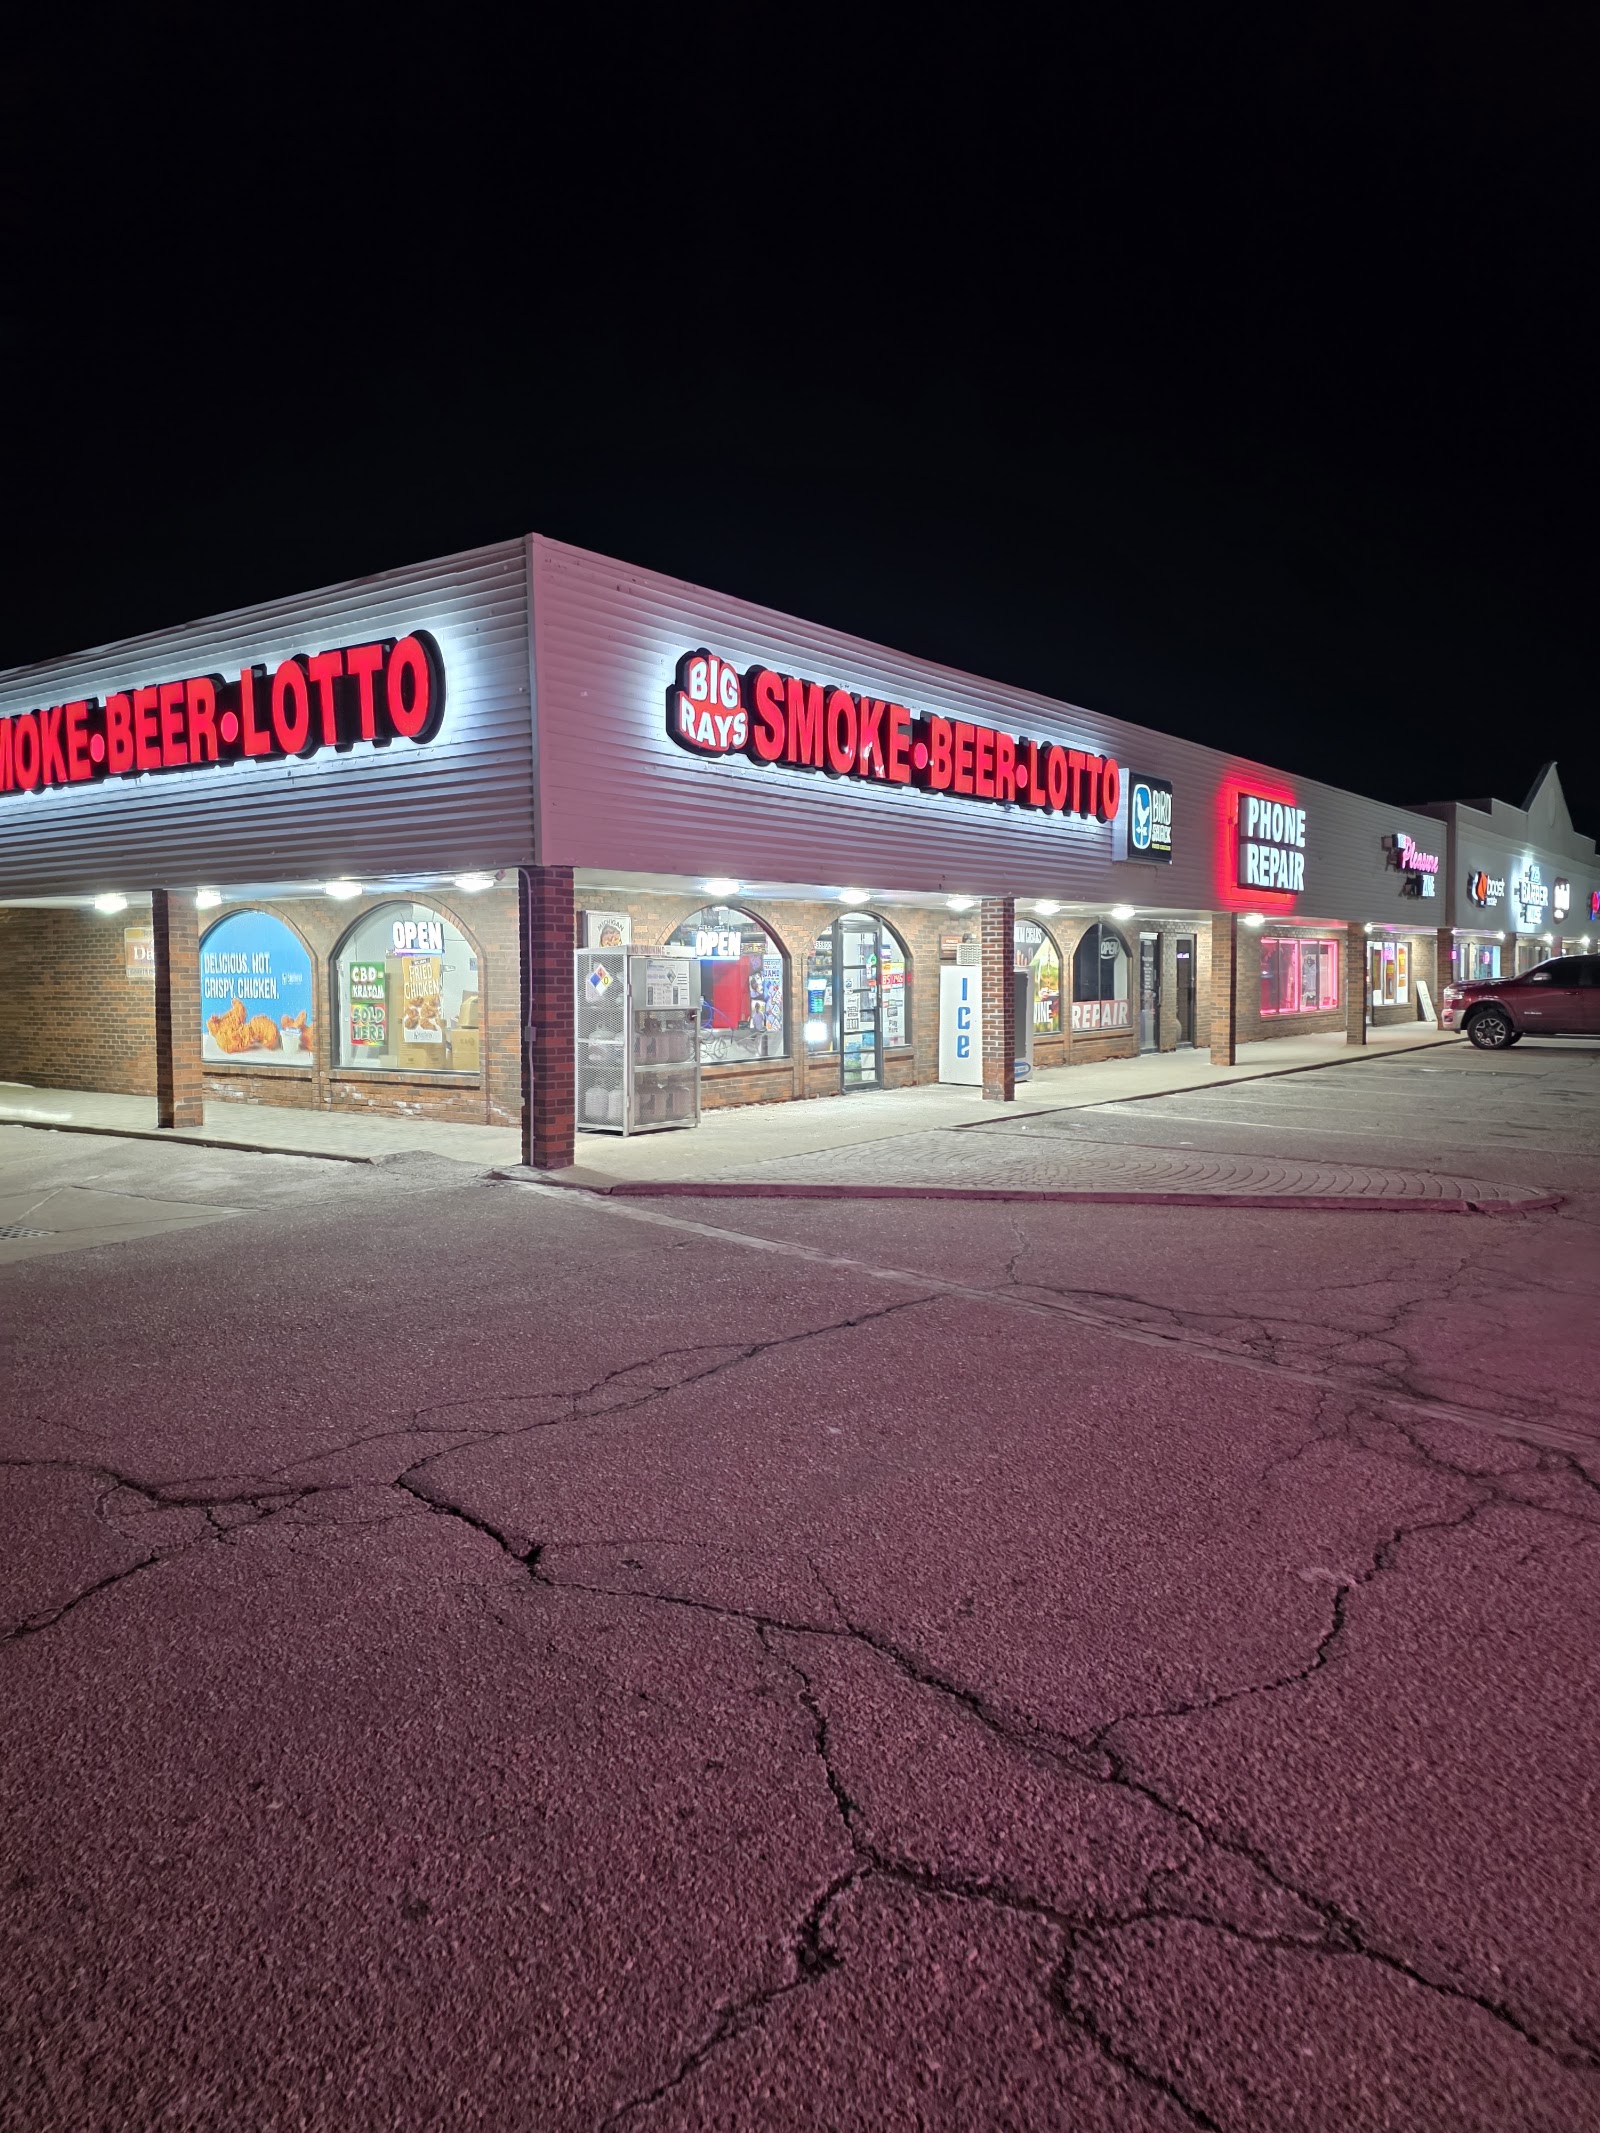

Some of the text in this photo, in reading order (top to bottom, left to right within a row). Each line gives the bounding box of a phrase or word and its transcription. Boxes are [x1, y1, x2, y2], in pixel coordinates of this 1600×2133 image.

[689, 655, 740, 708] BIG
[106, 678, 219, 774] BEER
[241, 636, 430, 756] LOTTO
[679, 693, 748, 750] RAYS
[754, 669, 1120, 821] SMOKE BEER LOTTO
[1152, 790, 1171, 825] BIRD
[1247, 796, 1306, 848] PHONE
[1247, 843, 1305, 892] REPAIR
[1402, 836, 1439, 873] Pleasure
[1487, 875, 1505, 896] boost
[393, 921, 443, 949] OPEN
[597, 918, 625, 932] MICHIGAN
[696, 931, 741, 956] OPEN
[203, 952, 272, 974] DELICIOUS. HOT.
[409, 963, 433, 982] FRIED
[204, 977, 236, 999] CRISPY.
[238, 977, 280, 1000] CHICKEN.
[352, 984, 384, 999] KRATOM
[404, 979, 440, 1000] CHICKEN
[352, 1007, 385, 1024] SOLD
[1072, 1001, 1128, 1029] REPAIR
[352, 1025, 385, 1041] HERE
